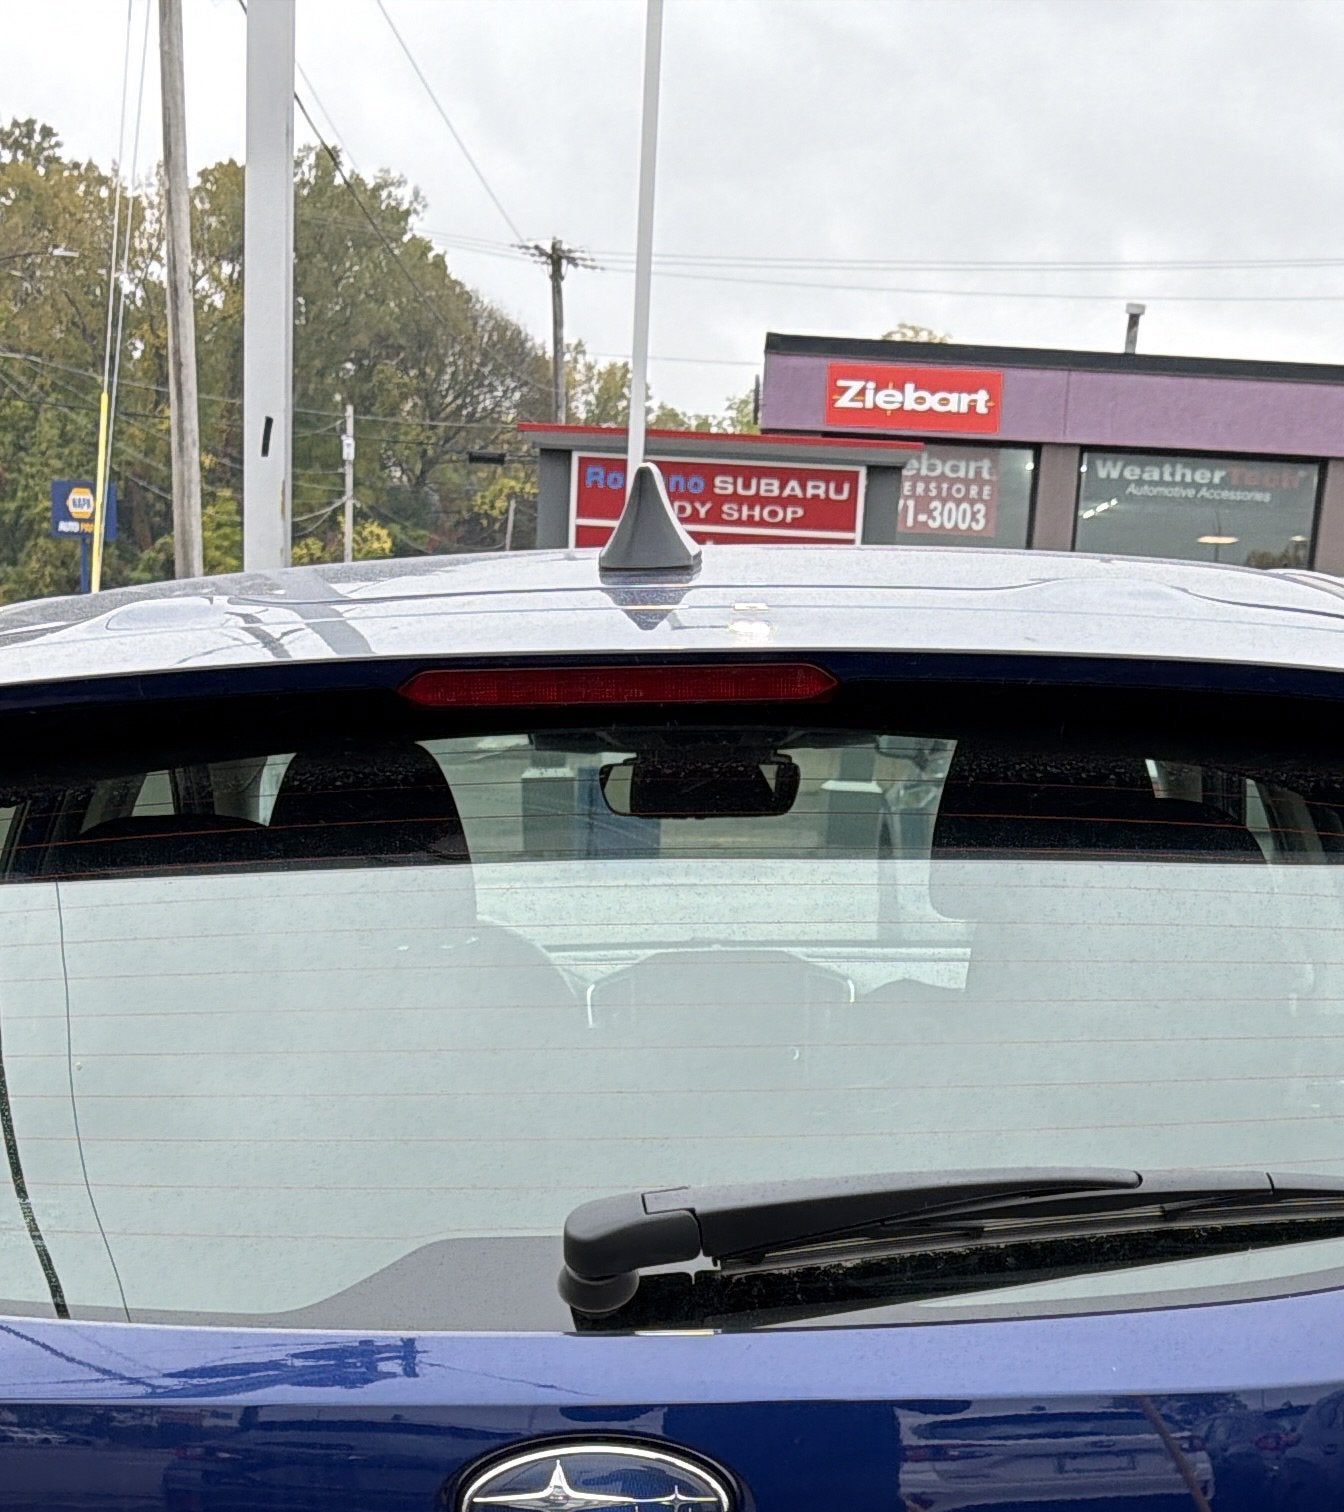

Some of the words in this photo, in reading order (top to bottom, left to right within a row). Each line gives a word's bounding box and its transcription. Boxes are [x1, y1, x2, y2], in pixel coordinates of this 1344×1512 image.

[834, 379, 990, 414] Ziebart
[901, 452, 992, 480] ebart
[585, 464, 705, 494] Rono
[713, 475, 850, 501] SUBARU
[902, 481, 992, 500] ERSTORE
[674, 500, 712, 519] DY
[721, 503, 805, 524] SHOP
